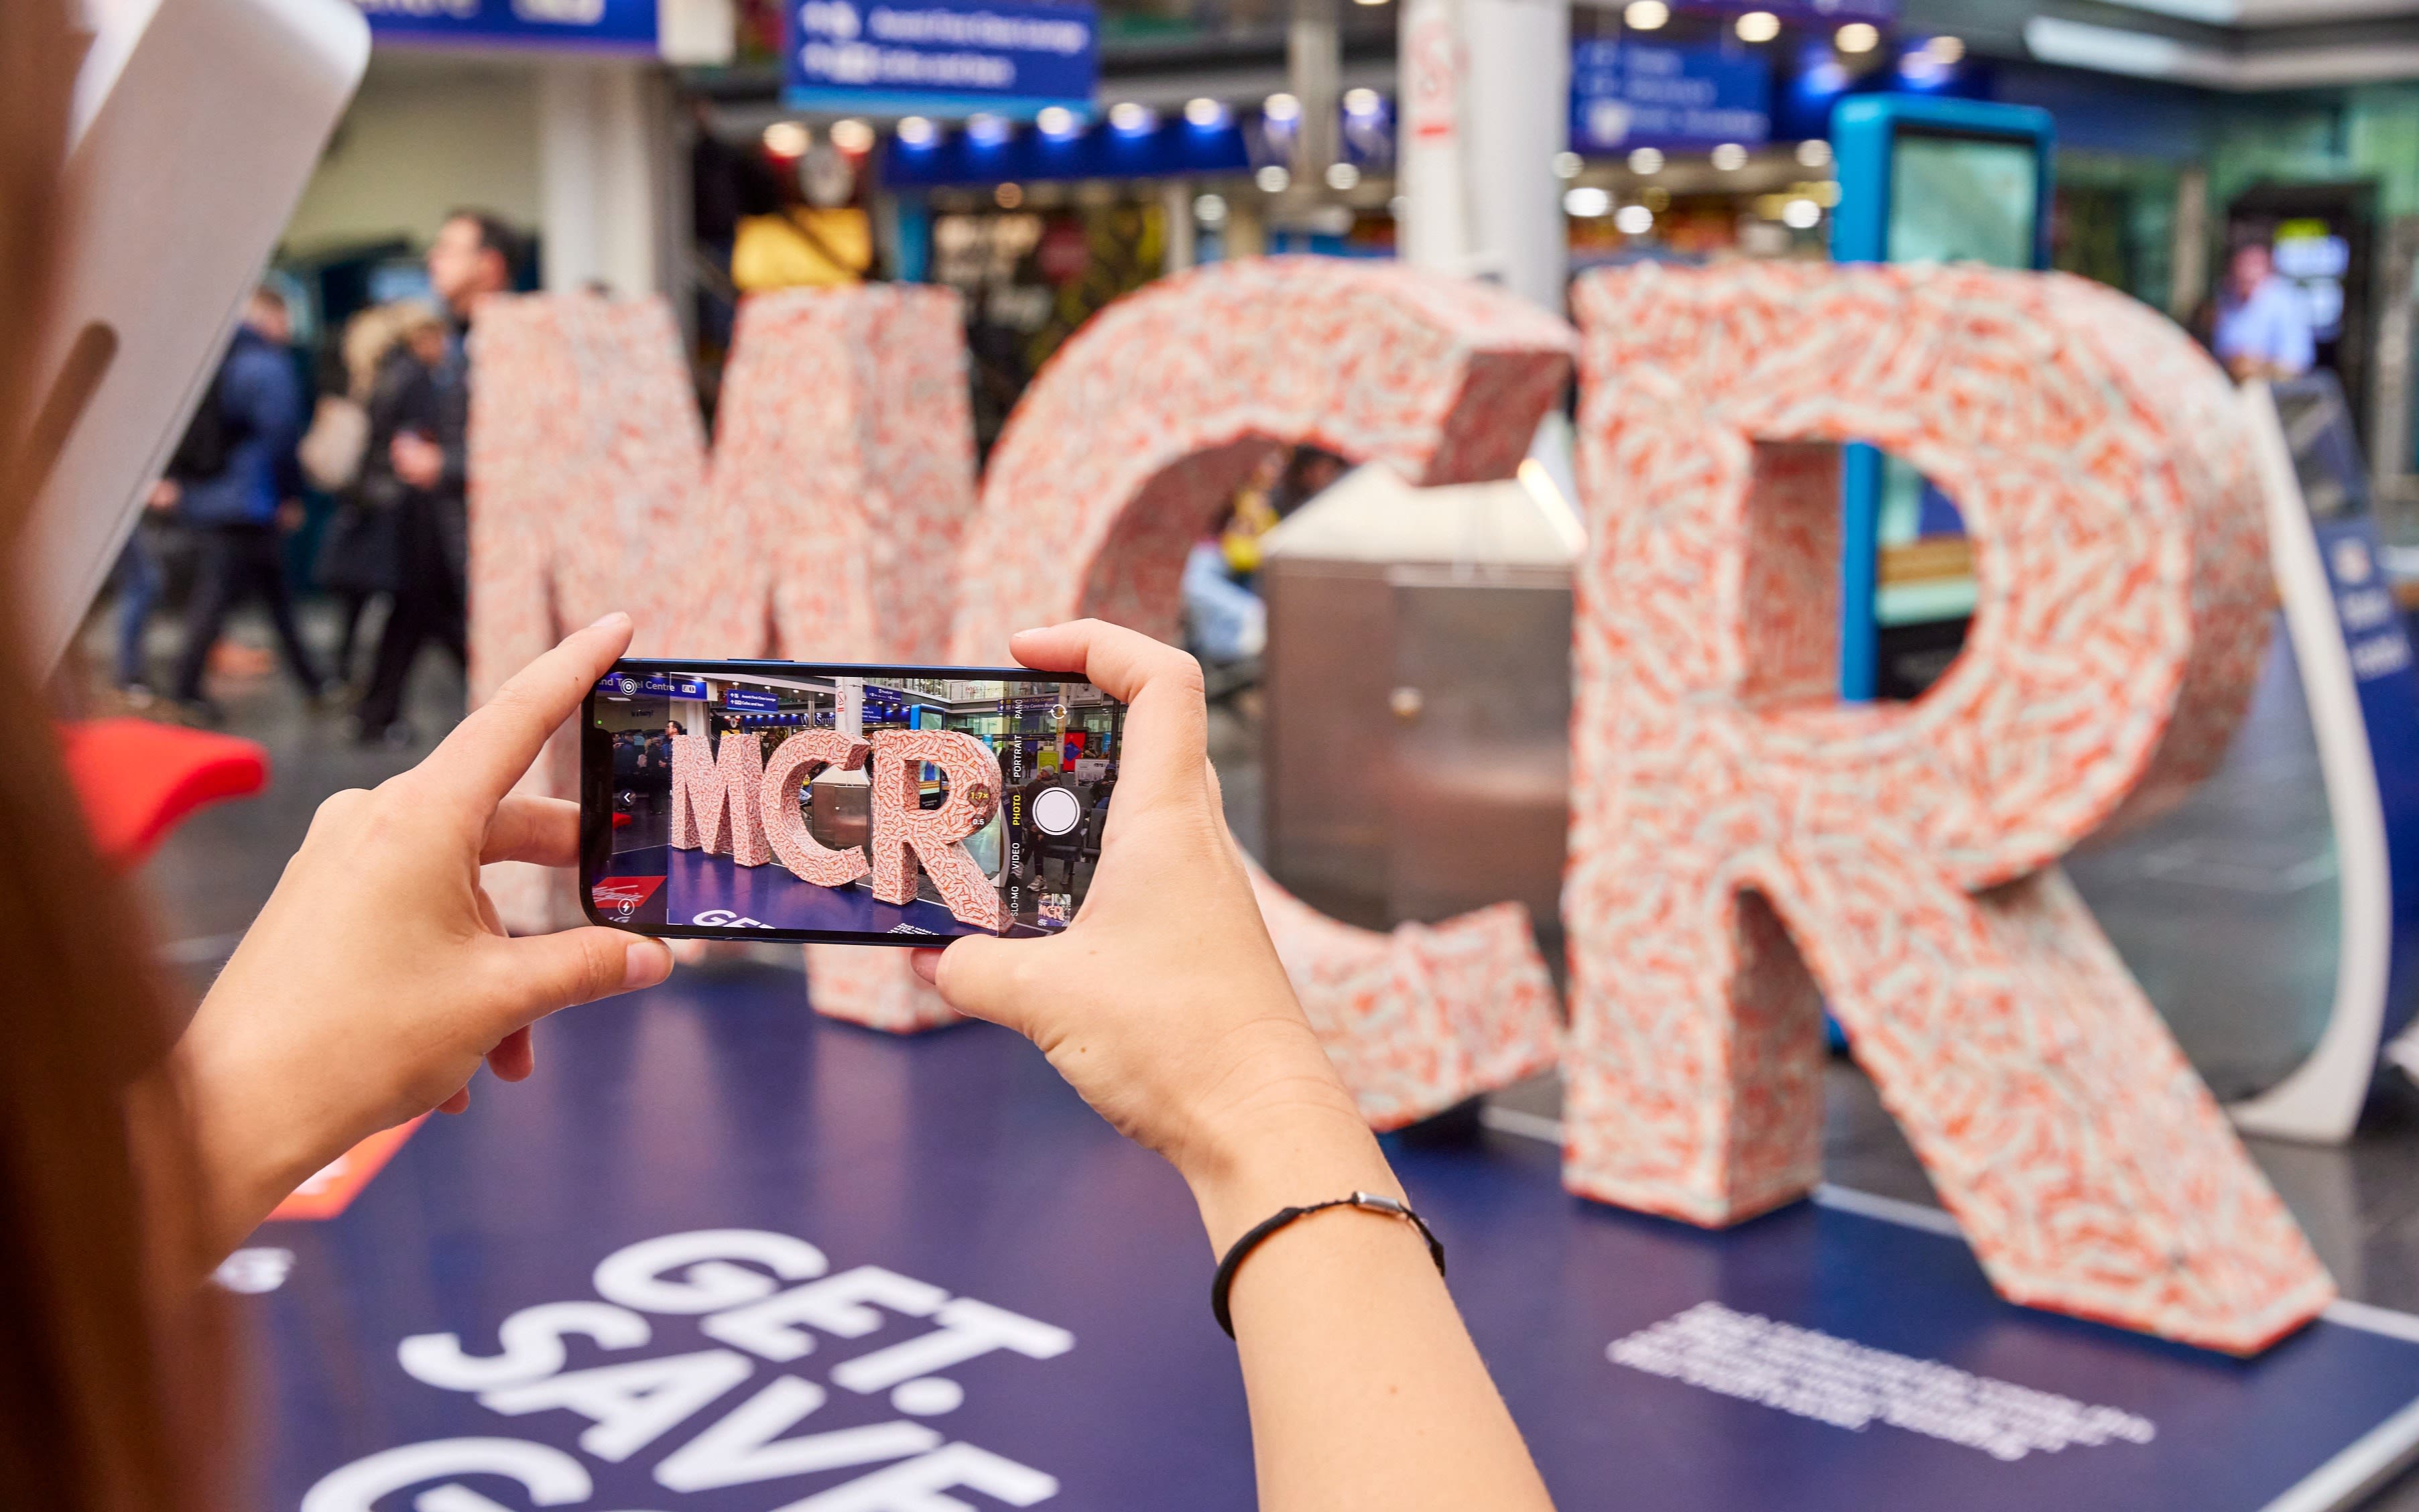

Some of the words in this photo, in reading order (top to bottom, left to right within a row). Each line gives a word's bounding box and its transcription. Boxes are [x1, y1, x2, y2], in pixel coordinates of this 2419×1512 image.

[645, 681, 675, 692] Centre
[1015, 699, 1023, 719] PANO
[1013, 735, 1022, 777] PORTRAIT
[466, 255, 2341, 1357] MCR
[1012, 795, 1021, 826] PHOTO
[670, 728, 1015, 933] MCR
[1011, 842, 1020, 869] VIDEO
[1011, 886, 1019, 916] SLO-MO
[594, 1228, 1075, 1416] GET.
